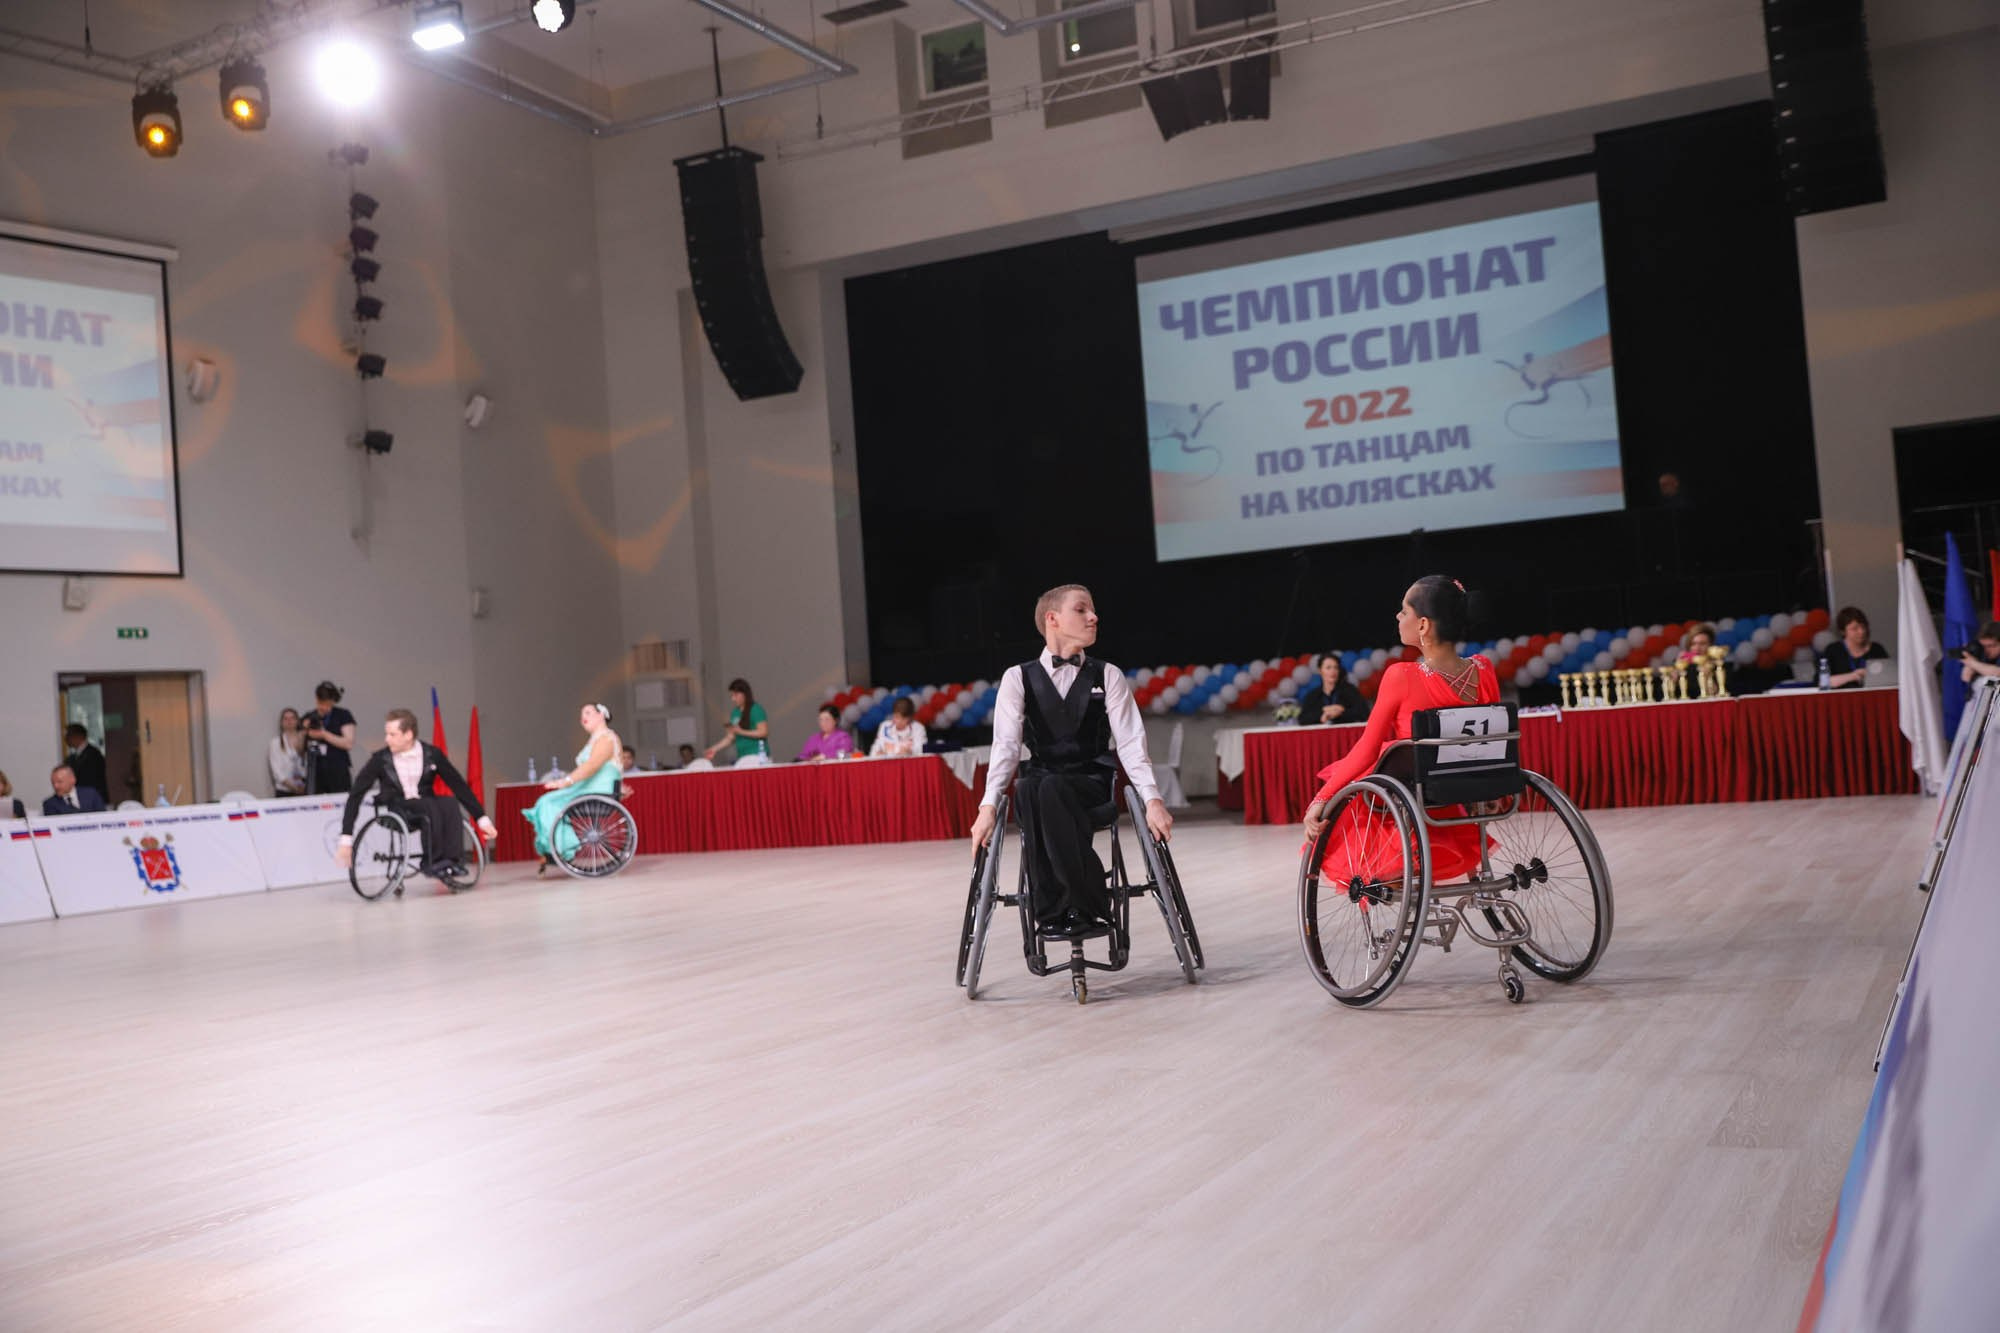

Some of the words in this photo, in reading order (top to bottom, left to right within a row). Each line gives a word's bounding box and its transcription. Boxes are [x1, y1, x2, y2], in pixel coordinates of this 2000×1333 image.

[1158, 236, 1557, 341] ЧЕМПИОНАТ
[1232, 312, 1482, 391] РОССИИ
[1303, 386, 1413, 430] 2022
[1256, 447, 1306, 477] ПО
[1311, 424, 1472, 469] ТАНЦАМ
[1240, 490, 1291, 520] НА
[1296, 464, 1496, 513] КОЛЯСКАХ
[1460, 718, 1489, 747] 51
